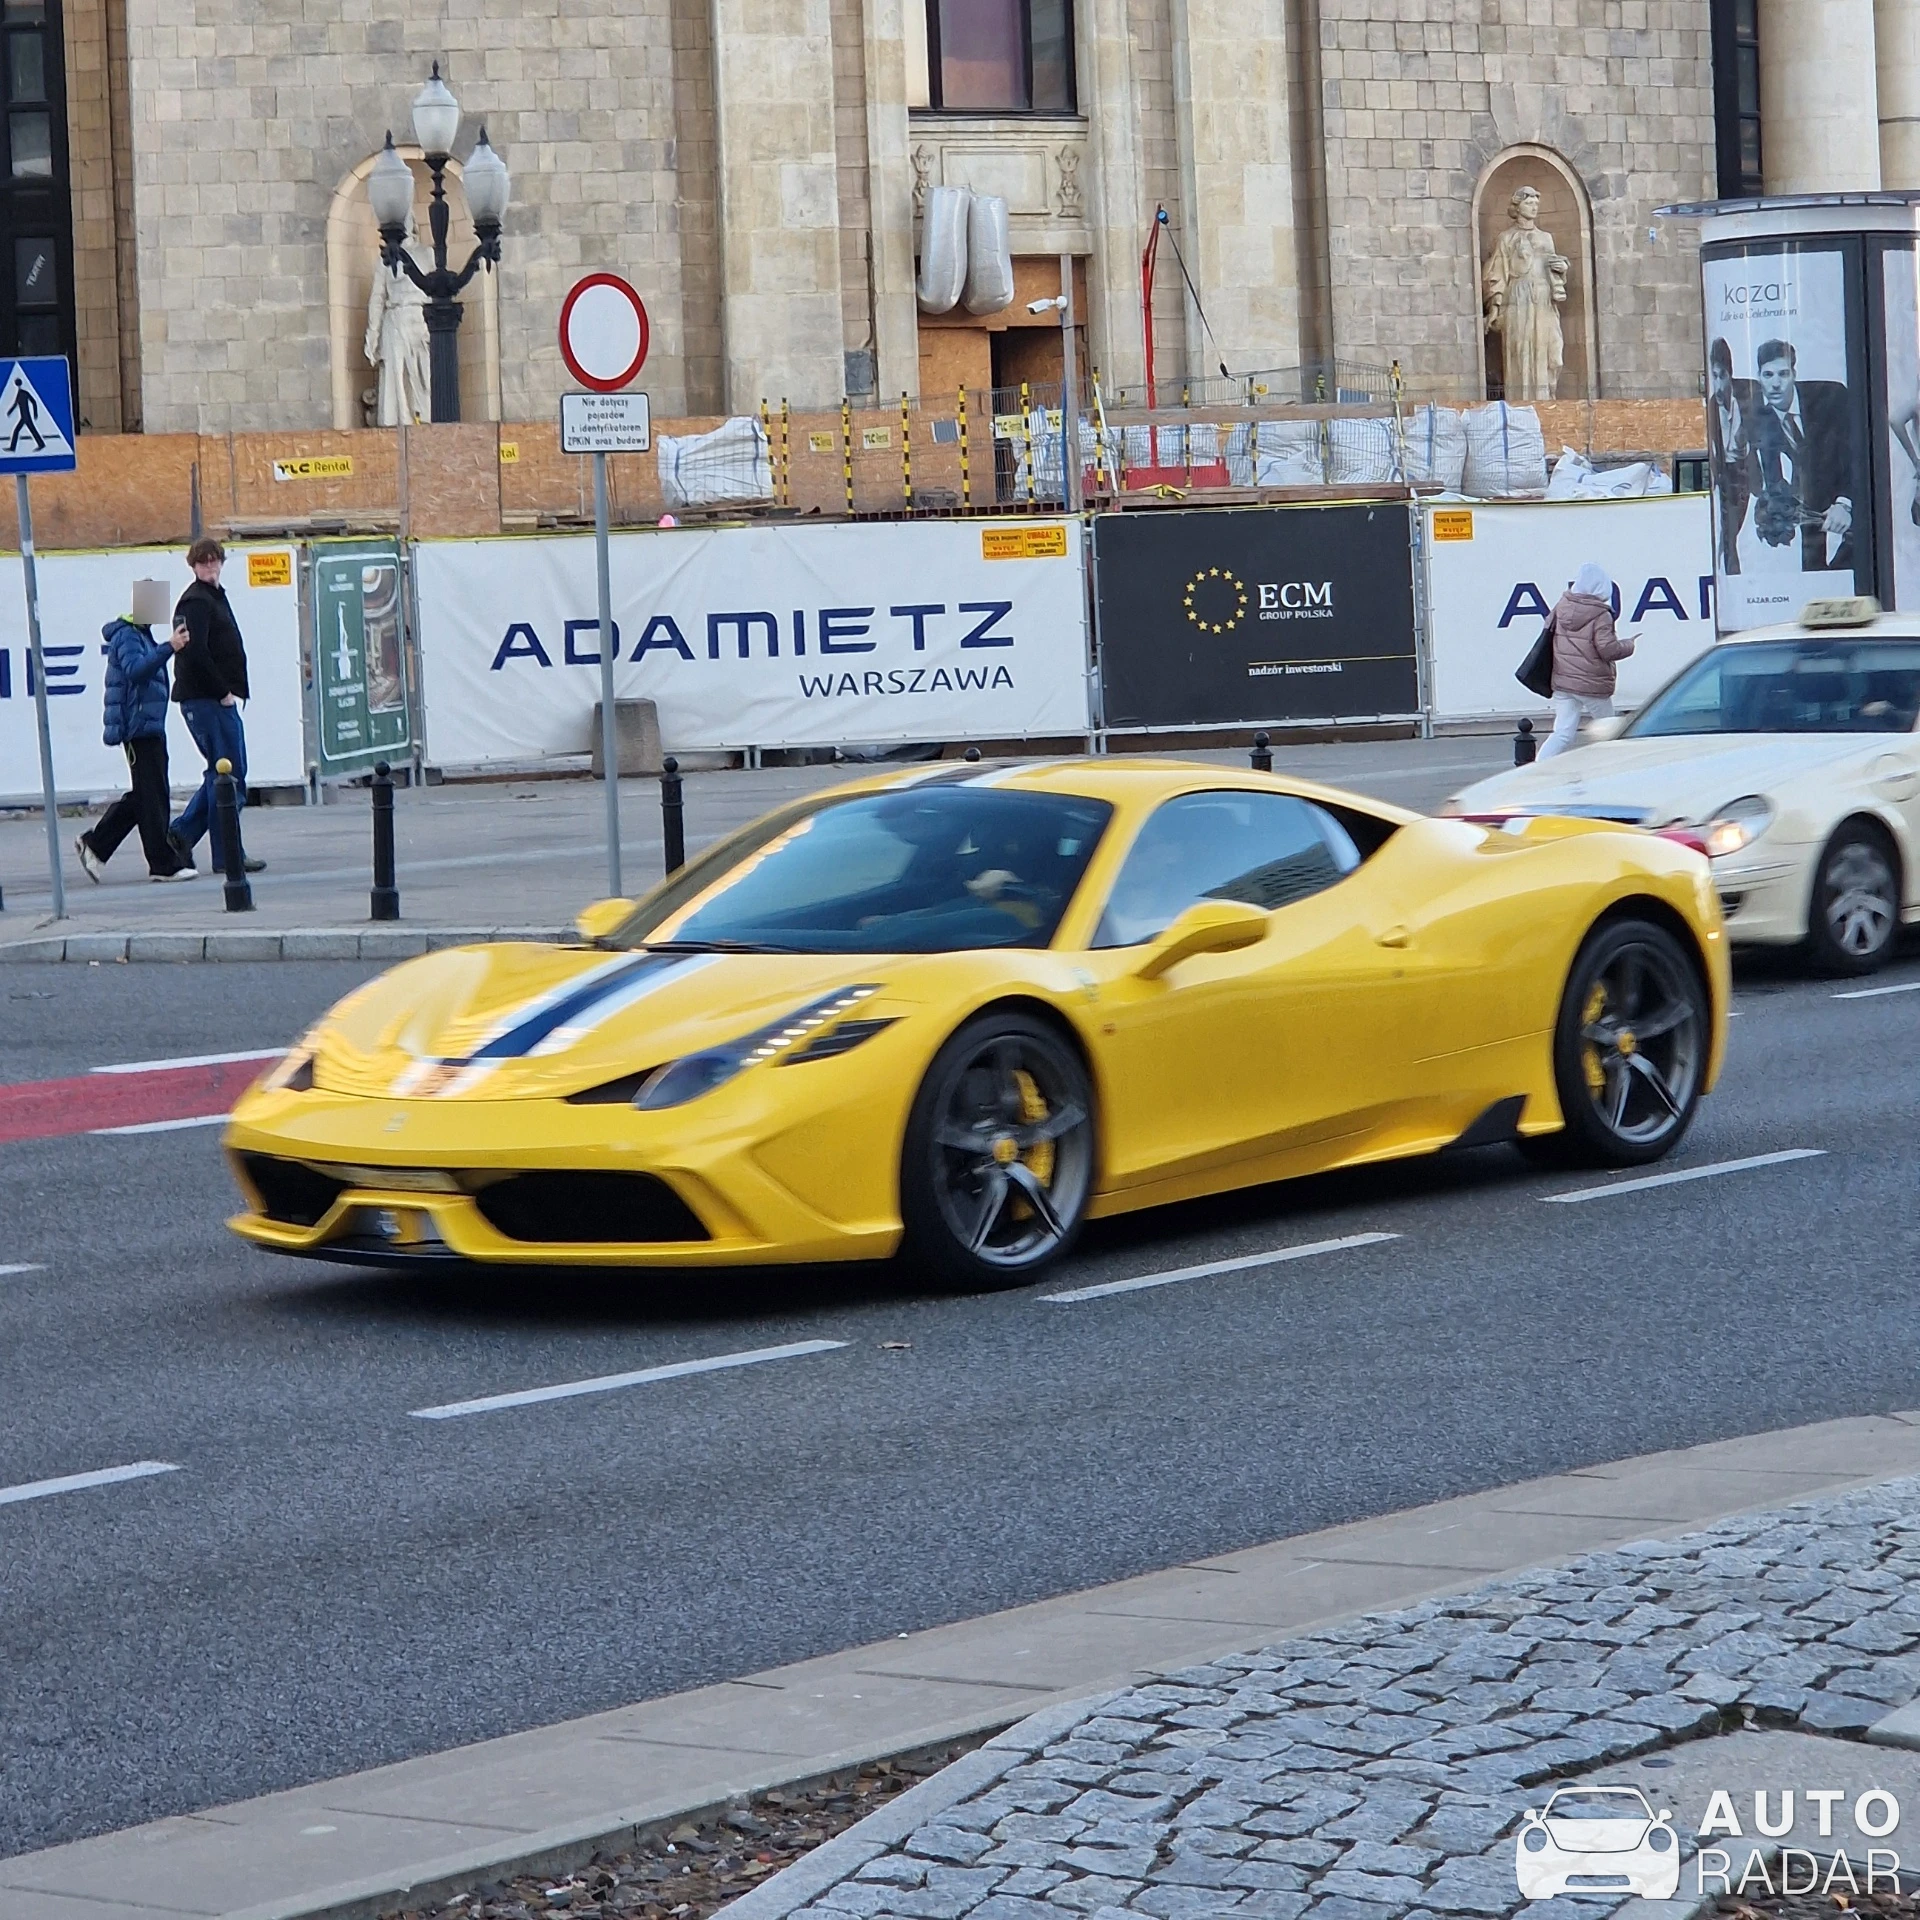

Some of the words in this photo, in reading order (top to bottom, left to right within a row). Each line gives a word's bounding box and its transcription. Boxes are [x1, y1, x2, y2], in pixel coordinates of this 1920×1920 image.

[1724, 283, 1793, 305] kazar
[1746, 308, 1798, 319] Celebration
[581, 397, 596, 407] Nie
[599, 397, 629, 409] dotyczy
[579, 424, 641, 434] identyfikatorem
[594, 438, 613, 446] oraz
[616, 436, 646, 447] budowy
[313, 460, 351, 473] Rental
[1257, 581, 1333, 609] ECM
[1747, 596, 1790, 604] KAZAR.COM
[1259, 611, 1293, 620] GROUP
[1295, 609, 1334, 619] POLSKA
[490, 601, 1015, 671] ADAMIETZ
[1249, 665, 1283, 676] nadzór
[1285, 662, 1342, 674] inwestorski
[798, 665, 1014, 698] WARSZAWA
